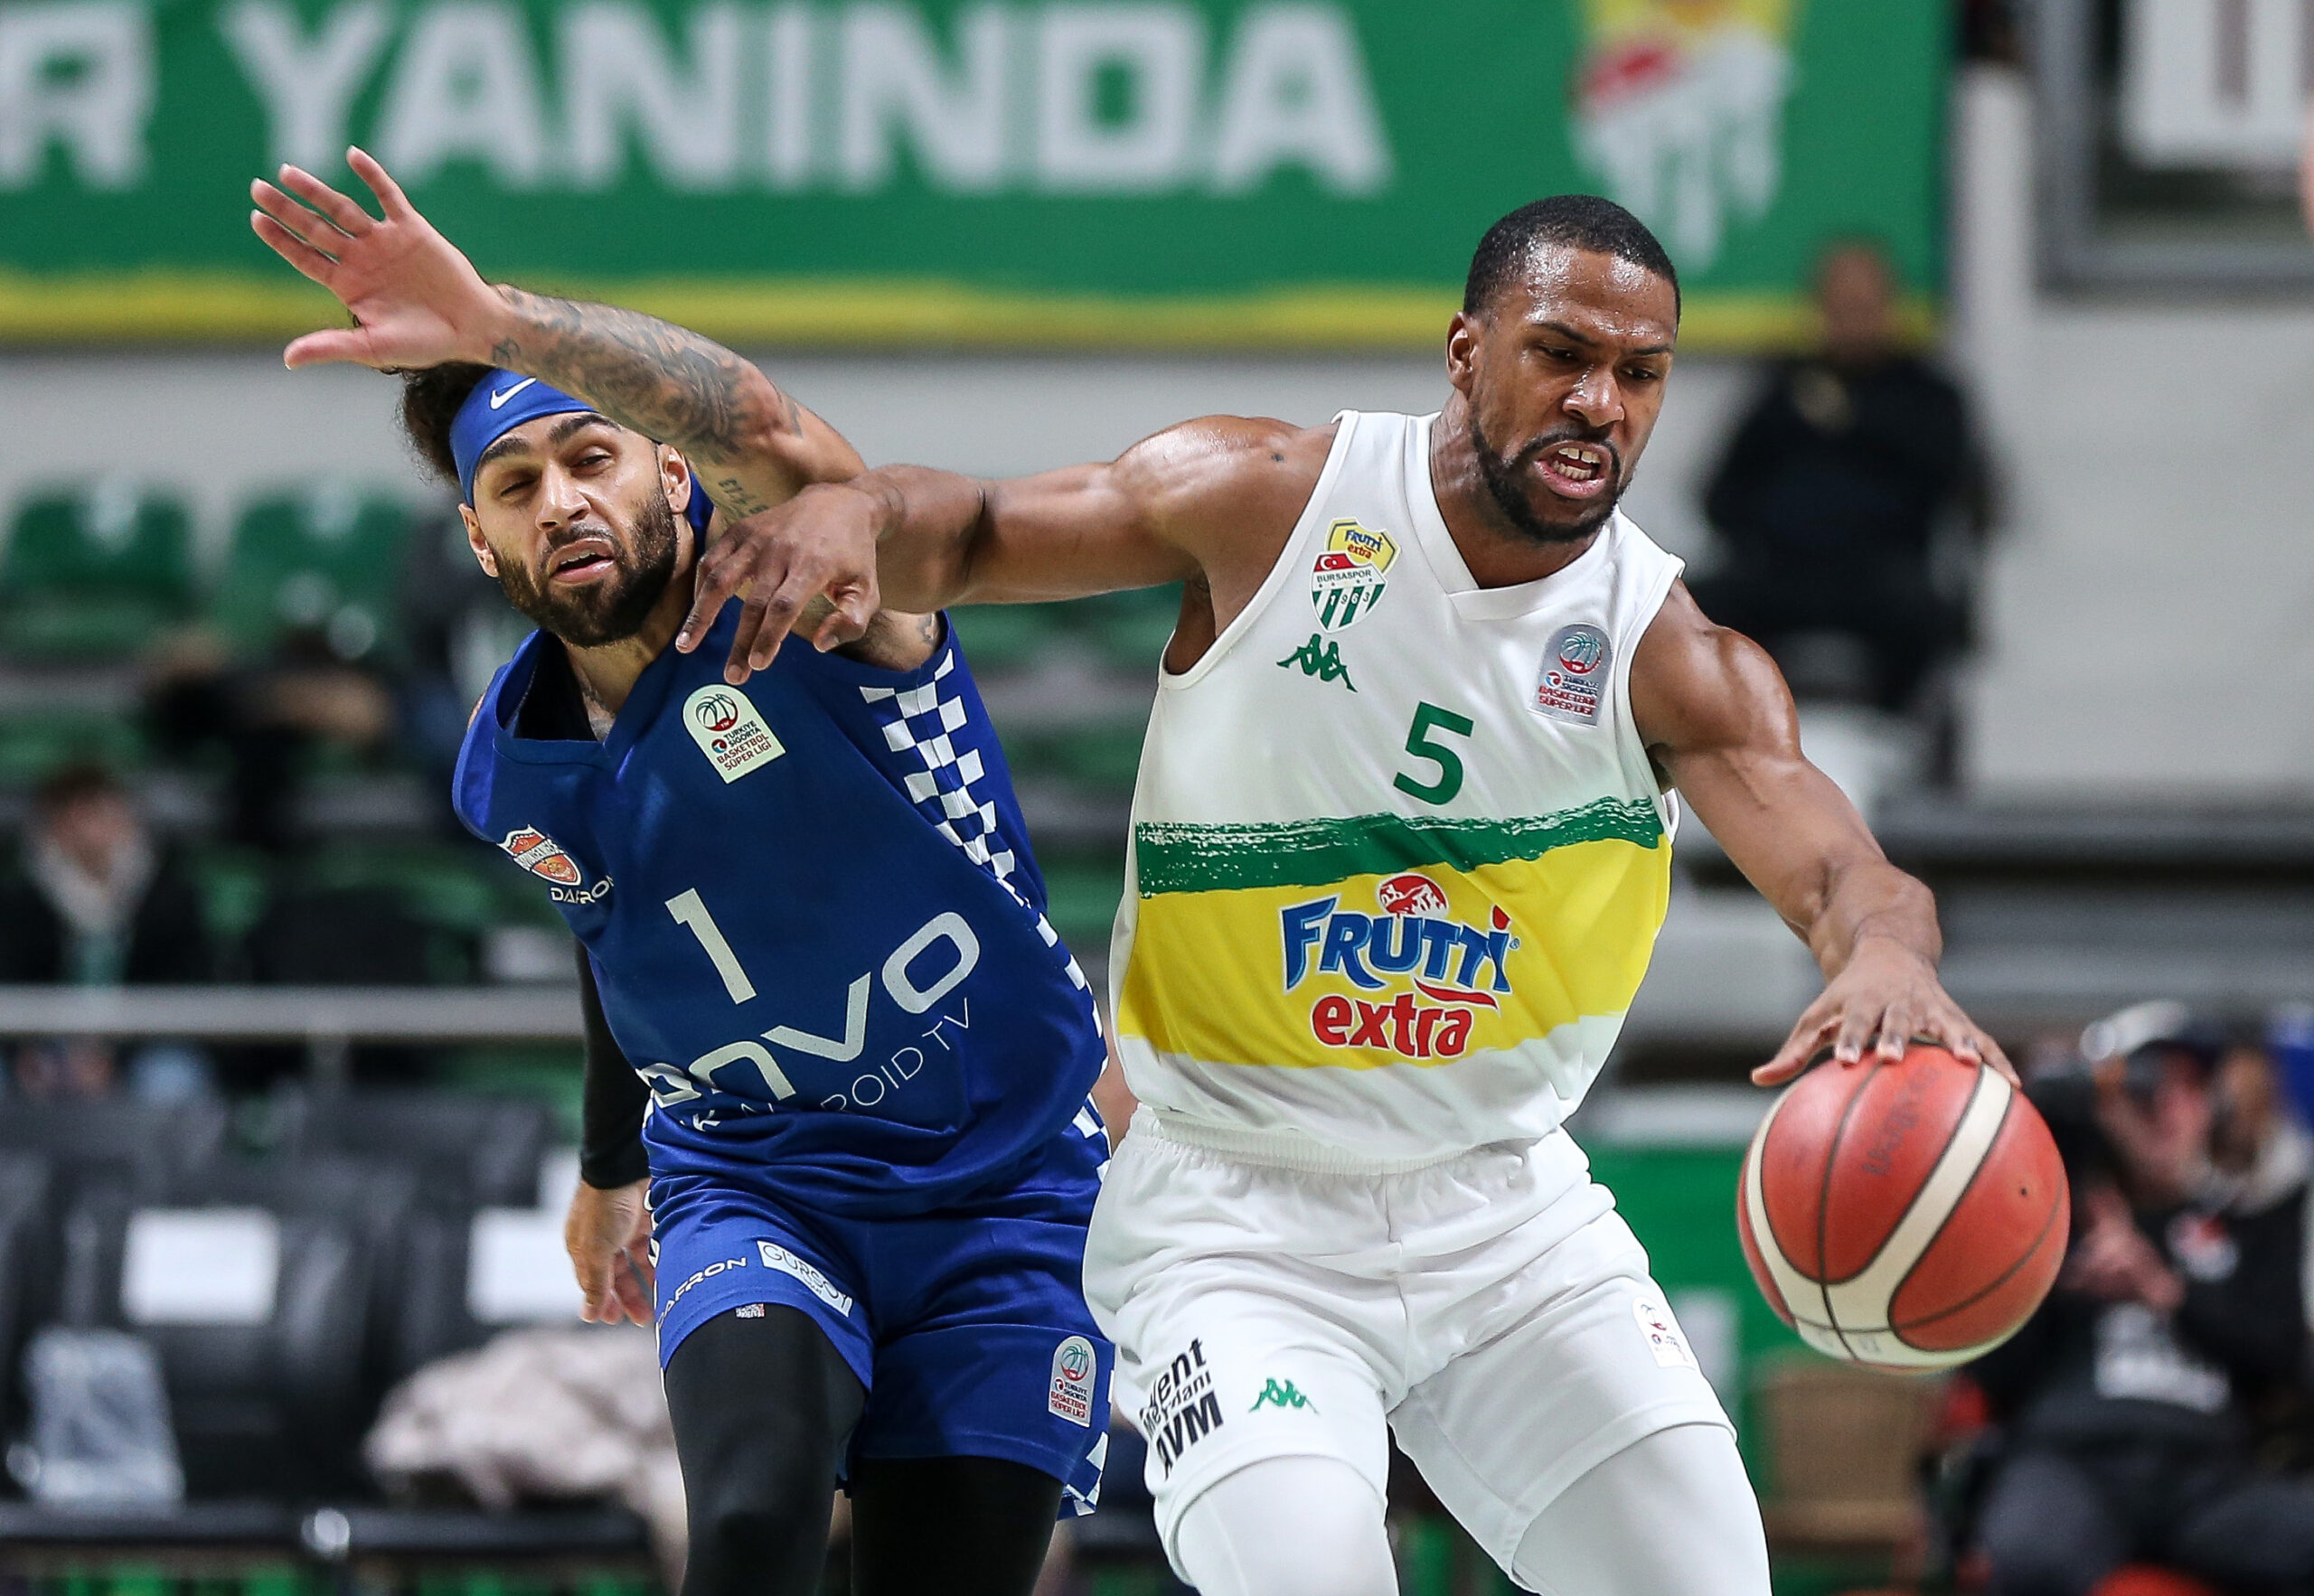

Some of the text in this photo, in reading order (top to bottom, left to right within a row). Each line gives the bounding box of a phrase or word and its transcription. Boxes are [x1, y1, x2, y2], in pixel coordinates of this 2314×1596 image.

[222, 3, 1394, 192] YANINDA
[1316, 569, 1372, 583] BURSASPOR
[1347, 543, 1373, 560] extra
[716, 735, 769, 765] BASKETBOL
[1393, 700, 1474, 806] 5
[664, 887, 757, 1006] 1
[921, 997, 970, 1051] TV
[1311, 992, 1474, 1058] extra
